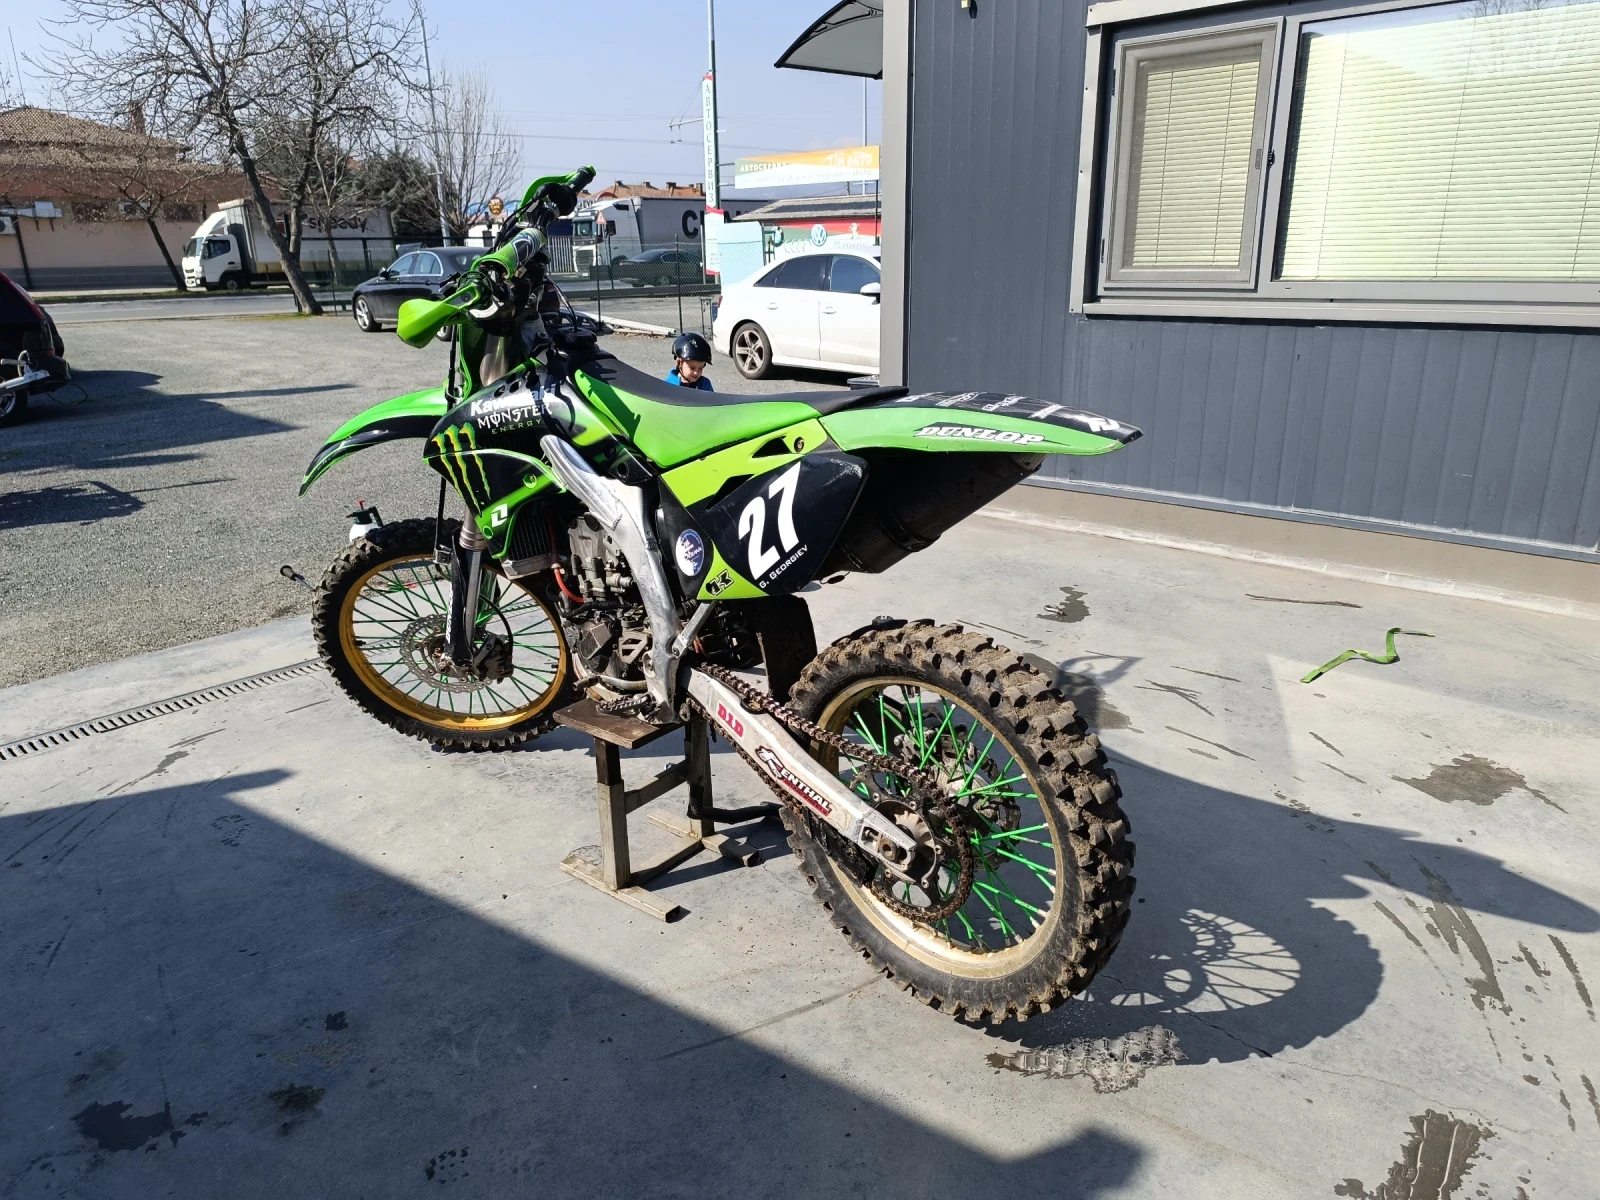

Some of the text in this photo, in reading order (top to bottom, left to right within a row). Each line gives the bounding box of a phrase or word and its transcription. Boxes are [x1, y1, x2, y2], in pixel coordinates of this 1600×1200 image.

[704, 83, 715, 203] АВТОСЕРВИЗ
[477, 401, 553, 429] MONSTER
[491, 419, 542, 435] ENERGY
[913, 426, 1045, 446] DUNLOP
[738, 461, 801, 580] 27
[759, 544, 808, 589] G. GEORGIEV
